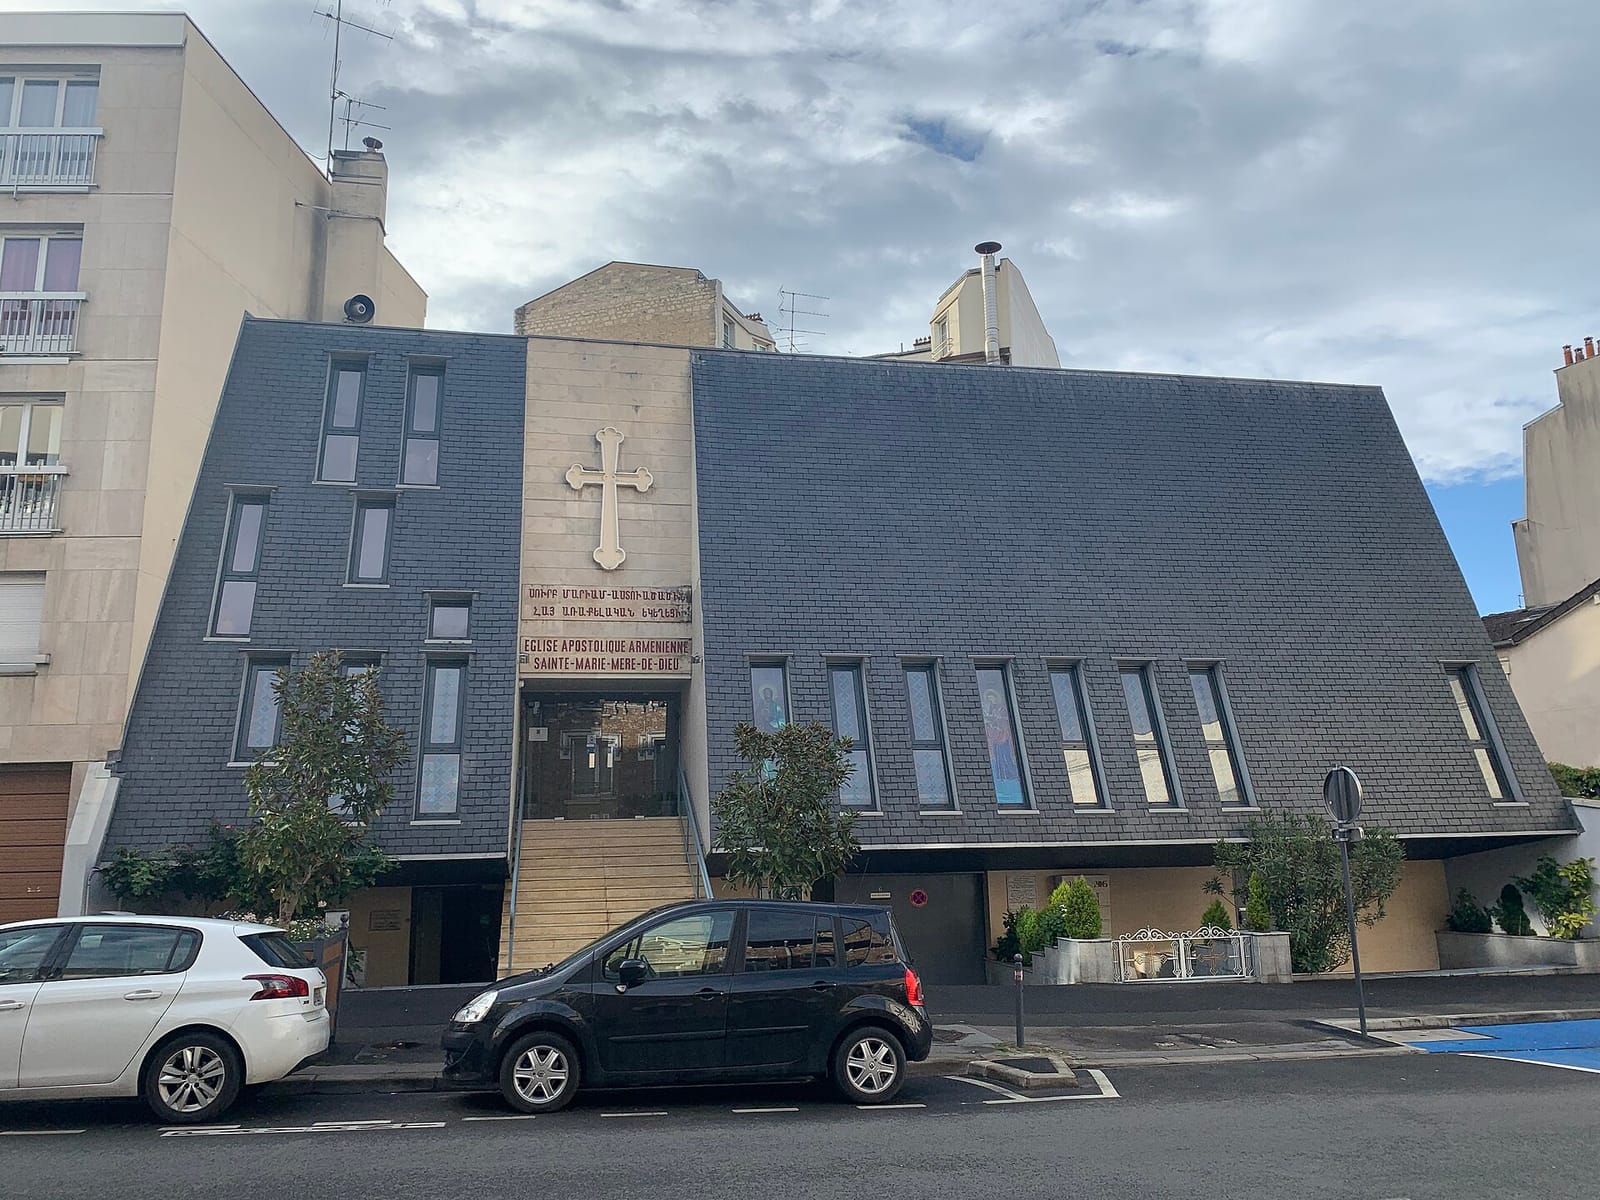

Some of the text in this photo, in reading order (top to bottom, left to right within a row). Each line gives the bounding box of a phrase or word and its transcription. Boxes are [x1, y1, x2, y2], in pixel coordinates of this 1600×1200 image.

[533, 606, 555, 617] ՀԱՅ
[524, 639, 689, 654] EGLISE APOSTOLIQUE ARMENIENNE
[534, 657, 679, 671] SAINTE-MARIE-MERE-DE-DIEU
